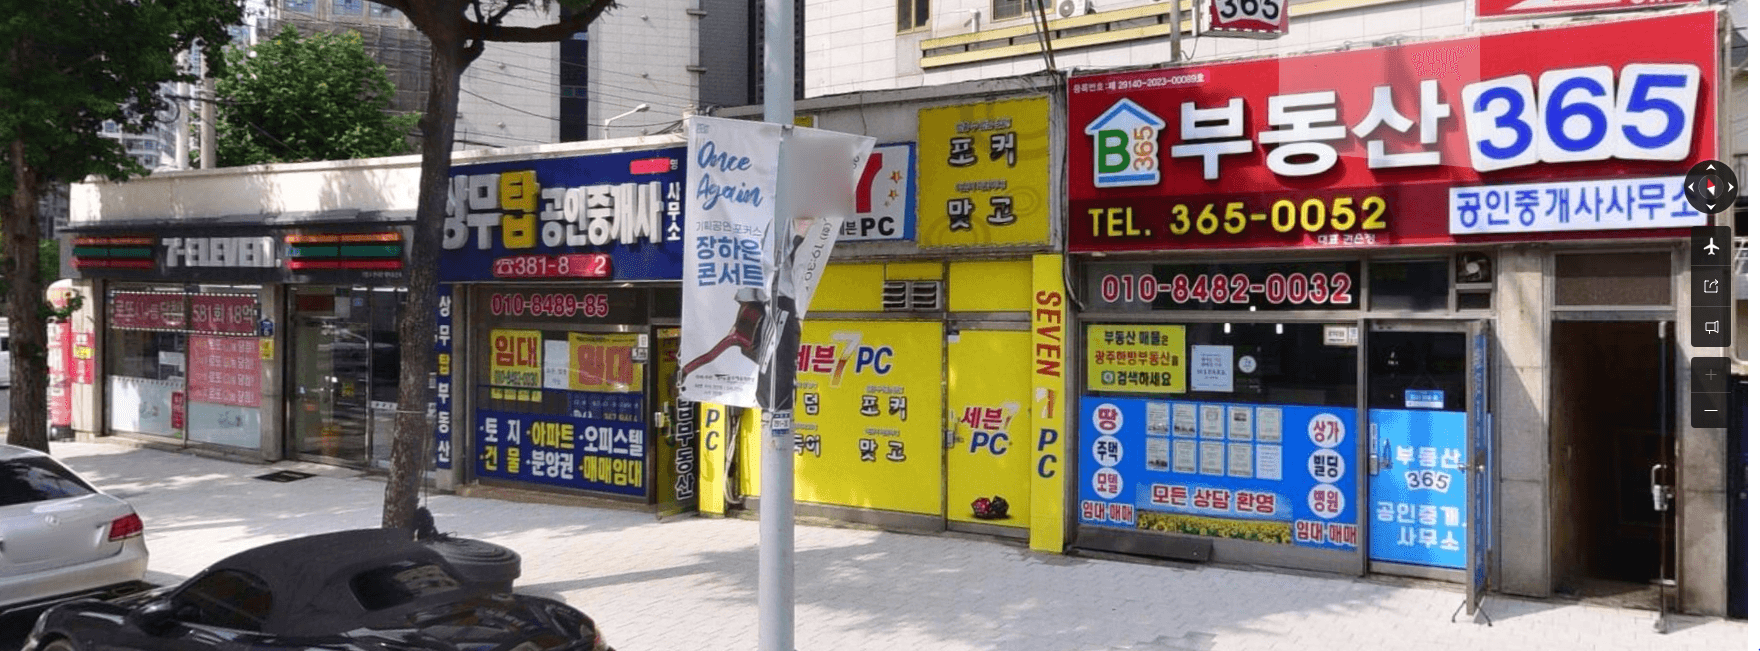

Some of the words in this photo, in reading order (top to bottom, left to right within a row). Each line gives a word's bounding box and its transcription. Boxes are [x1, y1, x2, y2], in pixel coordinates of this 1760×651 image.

[1171, 79, 1450, 181] 부동산
[1472, 73, 1688, 160] 365
[697, 141, 752, 173] Once
[1099, 129, 1131, 173] B
[696, 173, 763, 210] Again
[1456, 182, 1700, 229] 공인중개사사무소
[443, 170, 541, 250] 상무탑
[541, 181, 665, 247] 공인중개사
[667, 182, 681, 241] 사무소
[1088, 206, 1151, 237] TEL.
[1169, 196, 1386, 235] 365-0052
[861, 217, 895, 237] PC
[696, 235, 761, 263] 장하은
[697, 262, 764, 287] 콘서트
[1101, 273, 1352, 304] 010-8482-0032
[1035, 290, 1062, 378] SEVEN
[1104, 330, 1136, 346] 부동산
[494, 335, 538, 368] 임대
[856, 346, 893, 375] PC
[1117, 370, 1172, 387] 검색하세요
[960, 407, 1003, 430] 세븐
[1313, 420, 1340, 443] 상가
[531, 420, 575, 449] 아파트
[583, 425, 644, 457] 오피스텔
[970, 431, 1009, 455] PC
[1096, 440, 1119, 463] 주택
[531, 449, 574, 480] 분양권
[583, 455, 643, 488] 매매임대
[1313, 454, 1339, 479] 빌딩
[1395, 445, 1461, 468] 부동산
[1096, 473, 1119, 494] 모텔
[1407, 471, 1450, 490] 365
[1152, 485, 1188, 505] 모든
[1193, 488, 1231, 511] 상담
[1236, 491, 1276, 514] 환영
[1396, 525, 1461, 552] 사무소
